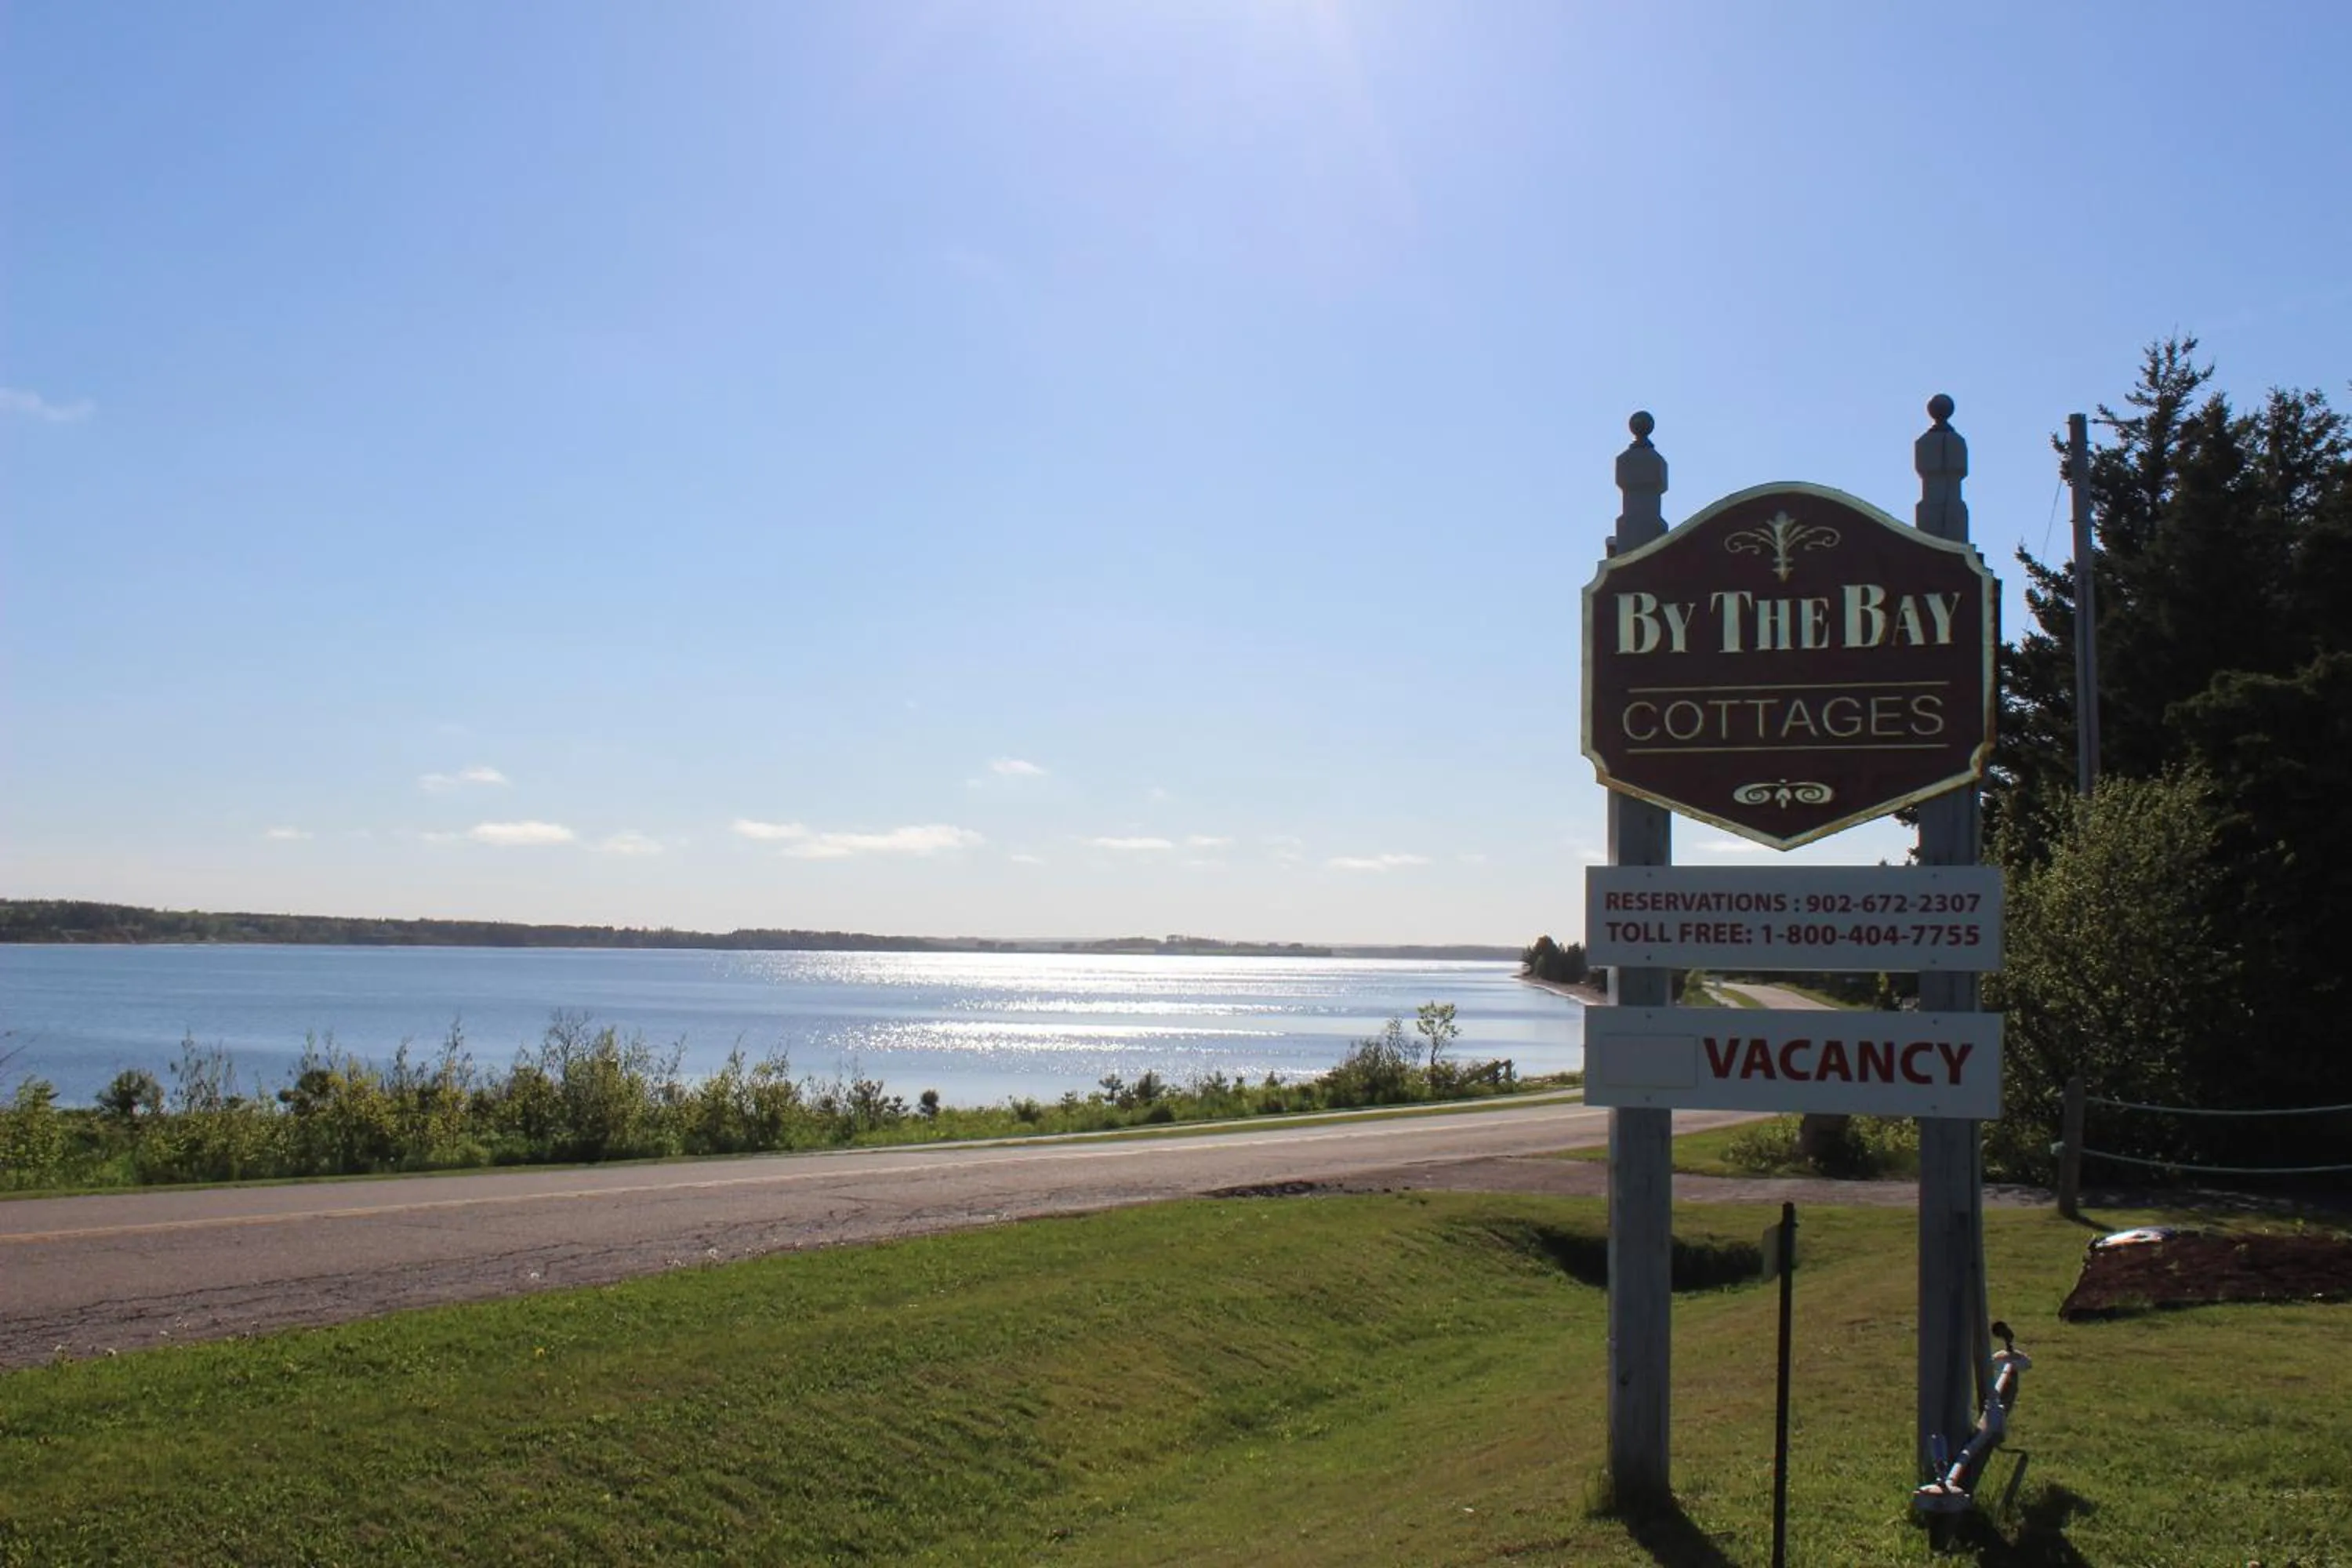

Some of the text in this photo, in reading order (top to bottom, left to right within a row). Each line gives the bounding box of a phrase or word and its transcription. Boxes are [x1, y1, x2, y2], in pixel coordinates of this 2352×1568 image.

[1622, 695, 1944, 741] COTTAGES
[1806, 894, 1981, 913] 902-672-2307
[1606, 922, 1980, 946] TOLL FREE: 1-800-404-7755
[1704, 1037, 1973, 1085] VACANCY
